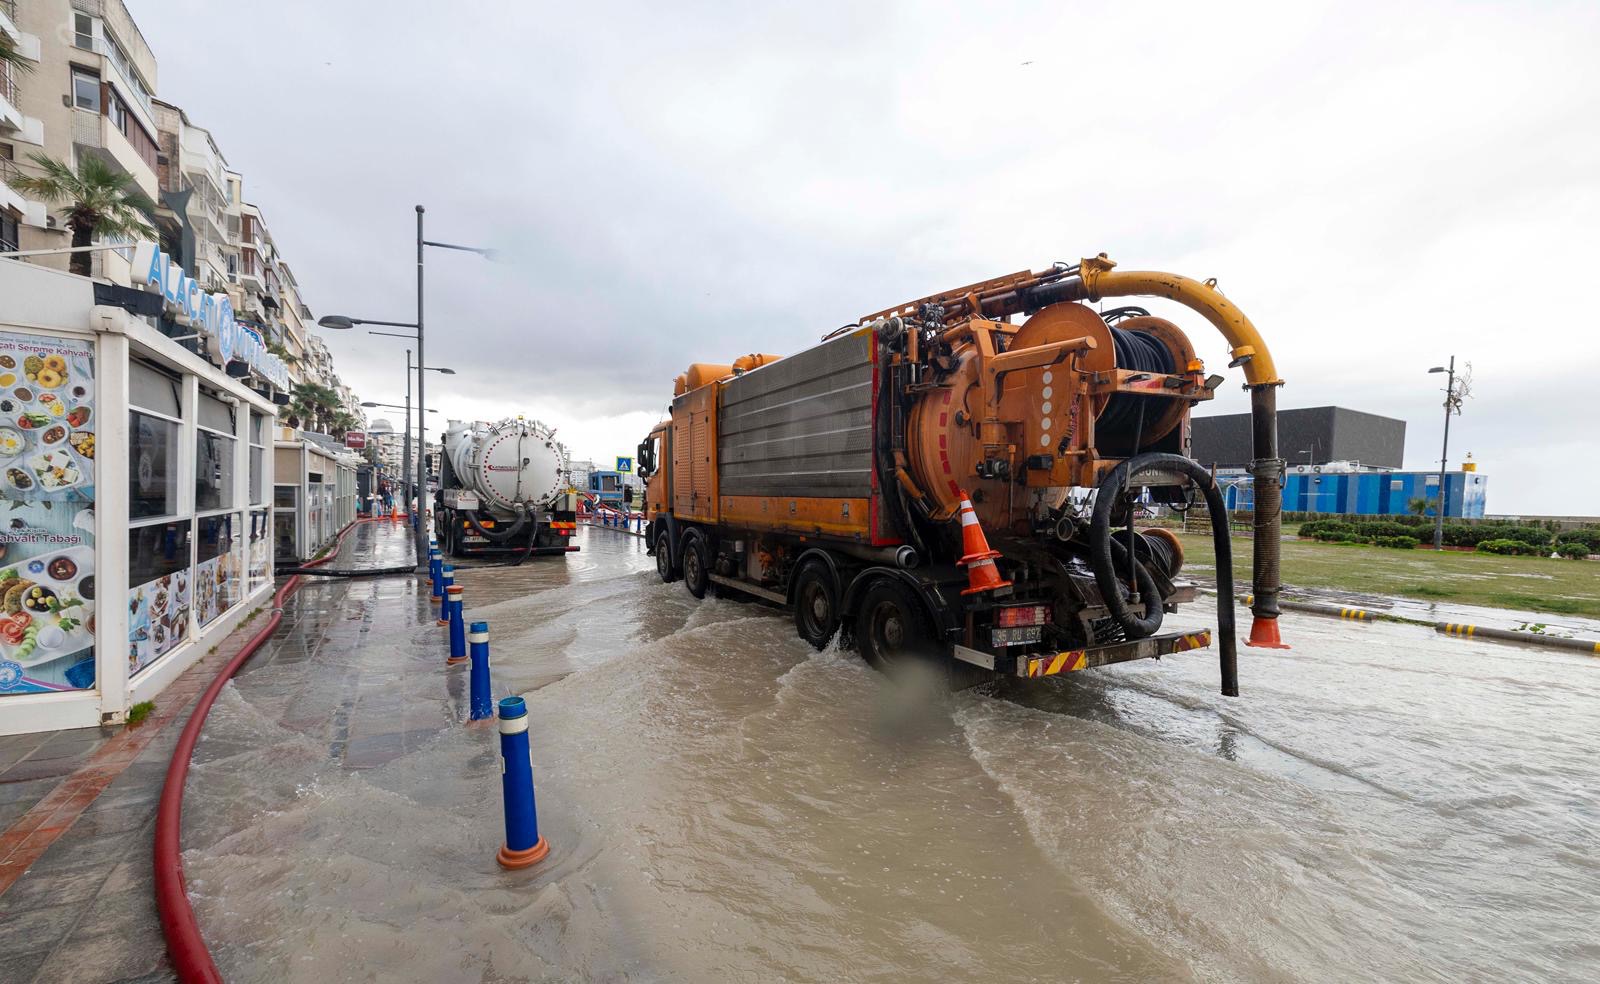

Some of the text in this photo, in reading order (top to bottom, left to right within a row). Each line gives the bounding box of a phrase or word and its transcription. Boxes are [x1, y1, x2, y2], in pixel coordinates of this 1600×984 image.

[18, 343, 54, 355] Serpme
[56, 348, 92, 358] Kahvaltı
[43, 534, 82, 544] Tabağı
[997, 629, 1007, 642] 35
